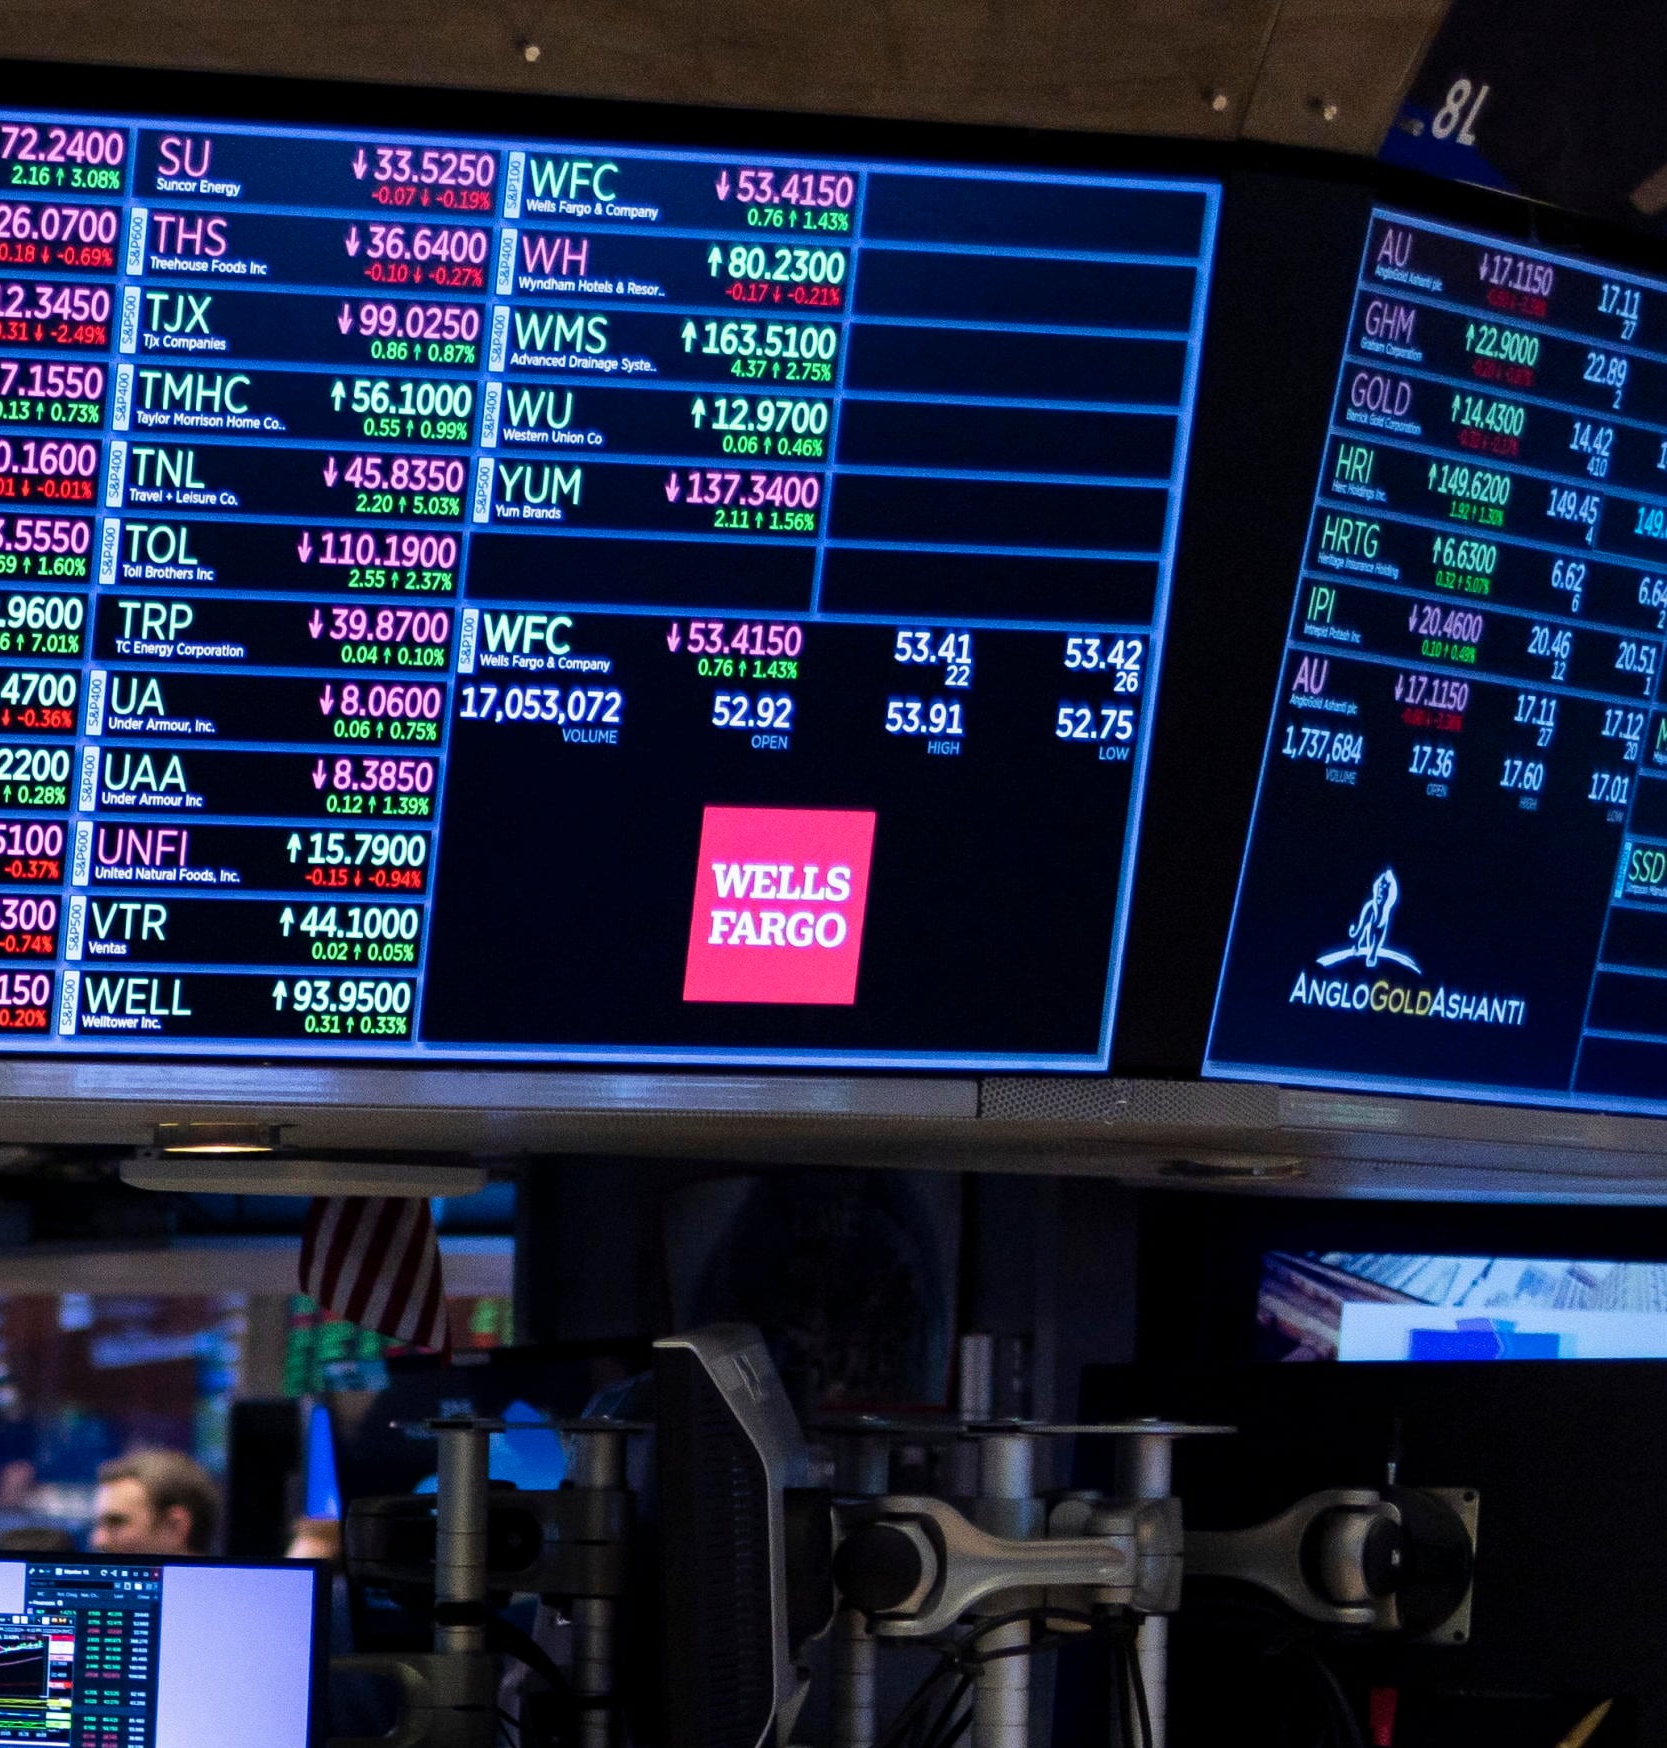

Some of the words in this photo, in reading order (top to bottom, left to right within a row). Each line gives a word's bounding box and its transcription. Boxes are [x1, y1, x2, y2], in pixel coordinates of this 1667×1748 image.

[2, 126, 123, 165] 72.2400
[1378, 229, 1411, 267] AU
[1488, 255, 1553, 298] 17.1150
[515, 312, 607, 354] WMS
[702, 322, 836, 360] 163.5100
[1366, 301, 1415, 343] GHM
[1475, 324, 1539, 366] 22.9000
[139, 370, 250, 414] TMHC
[352, 379, 472, 417] 56.1000
[1336, 444, 1373, 483] HRI
[1438, 465, 1510, 511] 149.6200
[894, 631, 971, 664] 53.41
[1064, 638, 1142, 670] 53.42
[460, 687, 621, 724] 17,053,072
[712, 696, 792, 728] 52.92
[1056, 708, 1133, 740] 52.75
[563, 728, 617, 743] VOLUME
[751, 735, 787, 749] OPEN
[1099, 747, 1129, 760] LOW
[1282, 726, 1363, 763] 1,737,684
[1409, 745, 1454, 778] 17.36
[712, 863, 850, 901] WELLS
[92, 902, 167, 940] VTR
[300, 906, 418, 939] 44.1000
[708, 910, 846, 947] FARGO
[85, 977, 191, 1015] WELL
